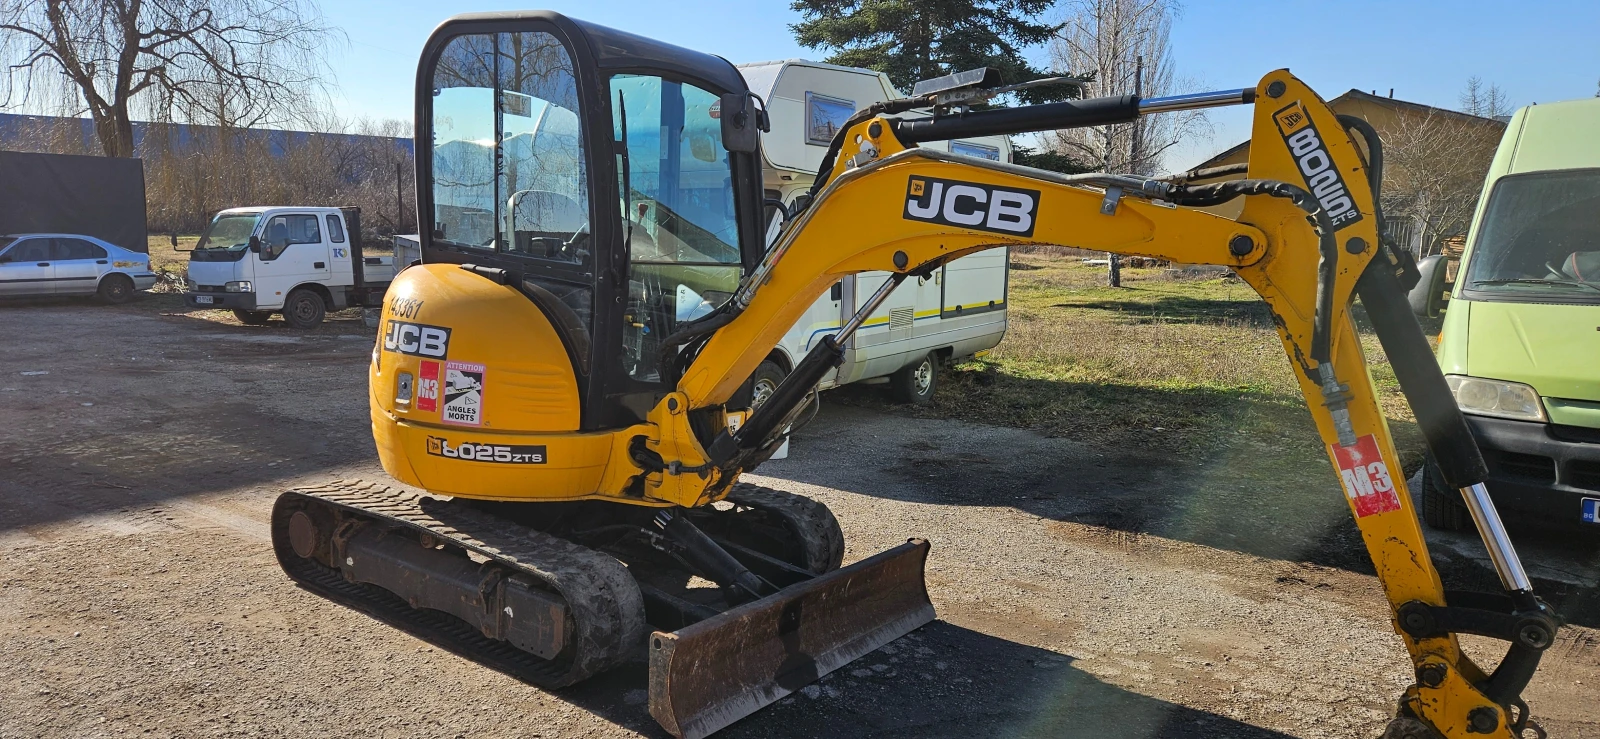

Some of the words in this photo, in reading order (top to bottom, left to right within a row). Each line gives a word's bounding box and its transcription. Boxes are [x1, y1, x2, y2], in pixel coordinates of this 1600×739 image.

[907, 182, 1034, 232] JCB
[388, 296, 424, 320] 143361
[385, 323, 447, 357] JCB
[446, 362, 484, 372] ATTENTION
[418, 378, 438, 399] M3
[447, 405, 476, 414] ANGLES
[448, 412, 475, 421] MORTS
[1341, 461, 1393, 498] M3
